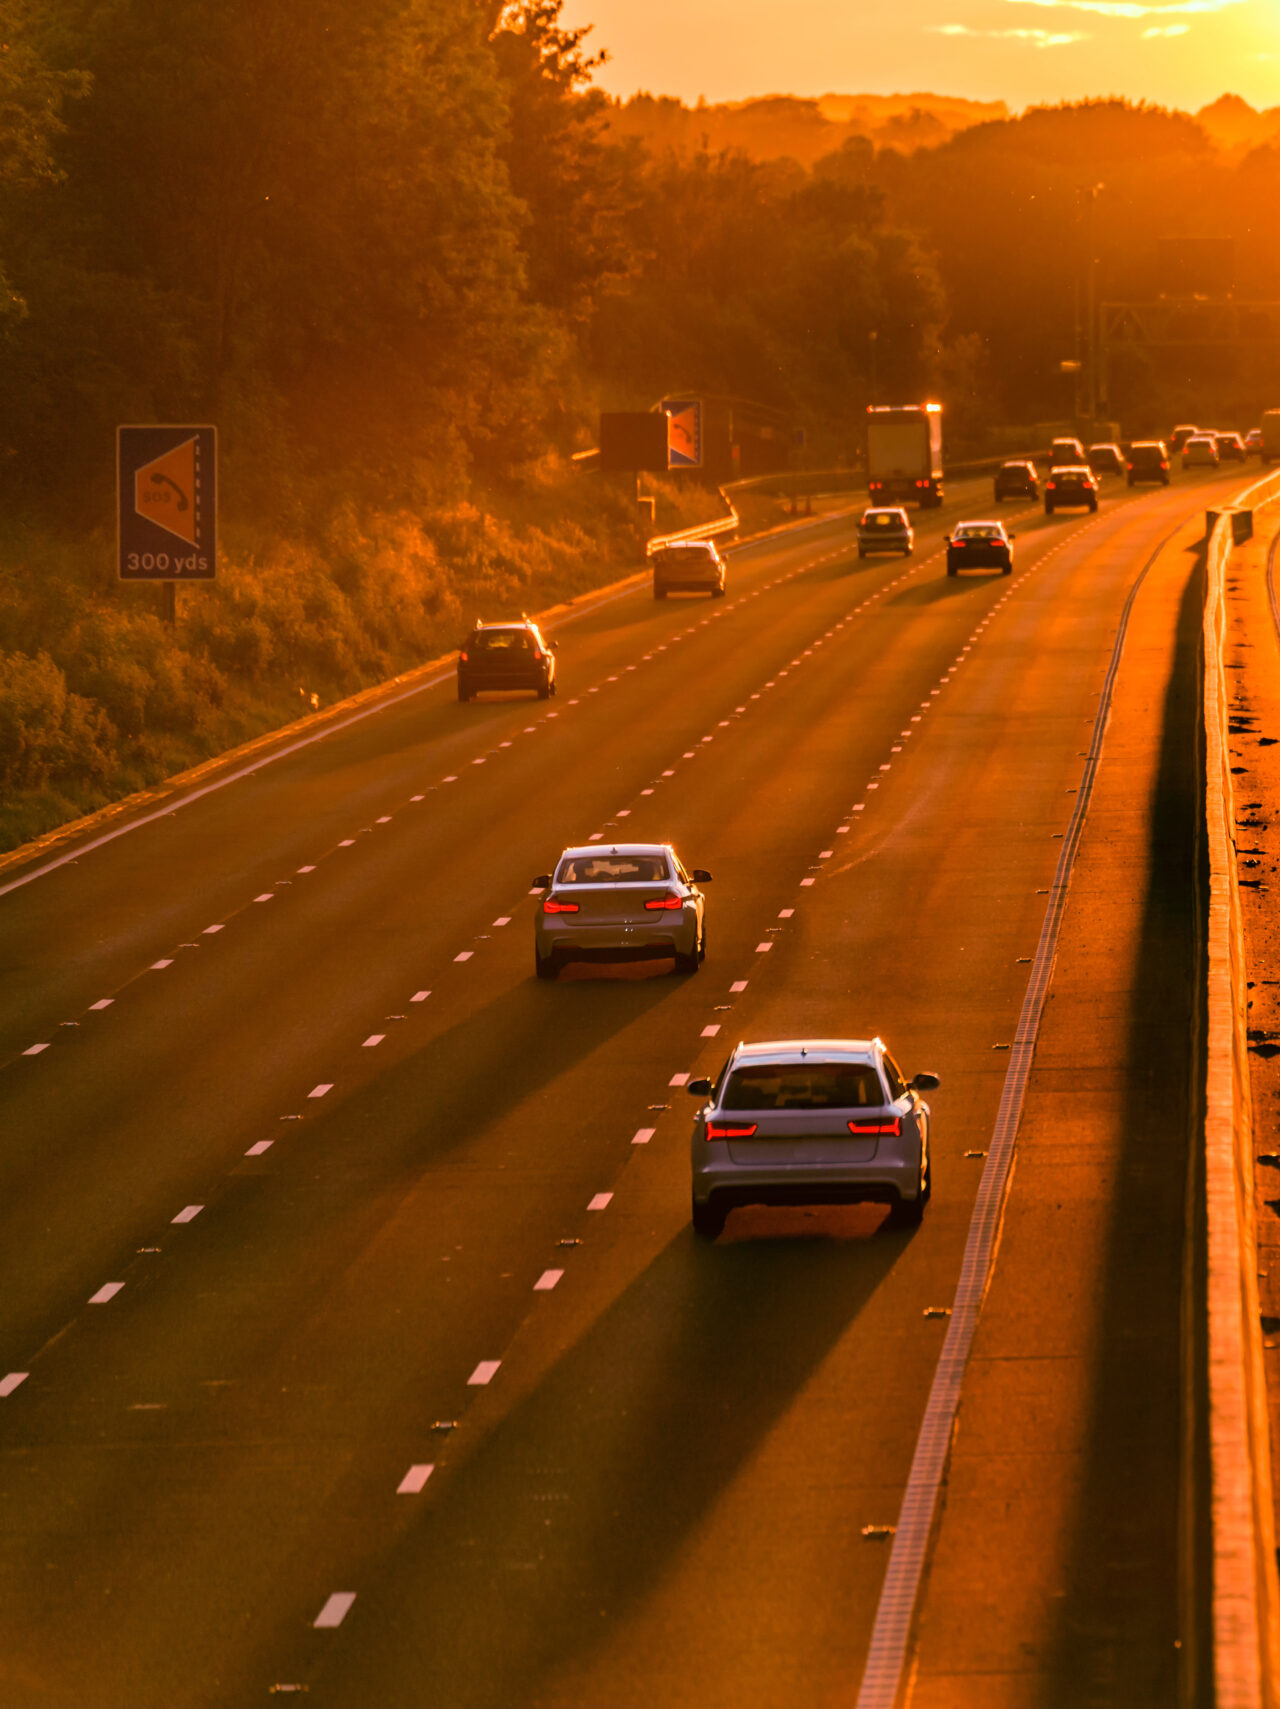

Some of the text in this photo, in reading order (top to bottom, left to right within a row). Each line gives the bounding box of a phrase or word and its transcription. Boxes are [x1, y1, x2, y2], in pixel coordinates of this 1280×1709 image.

[144, 491, 171, 503] SOS
[128, 553, 208, 573] 300 yds
